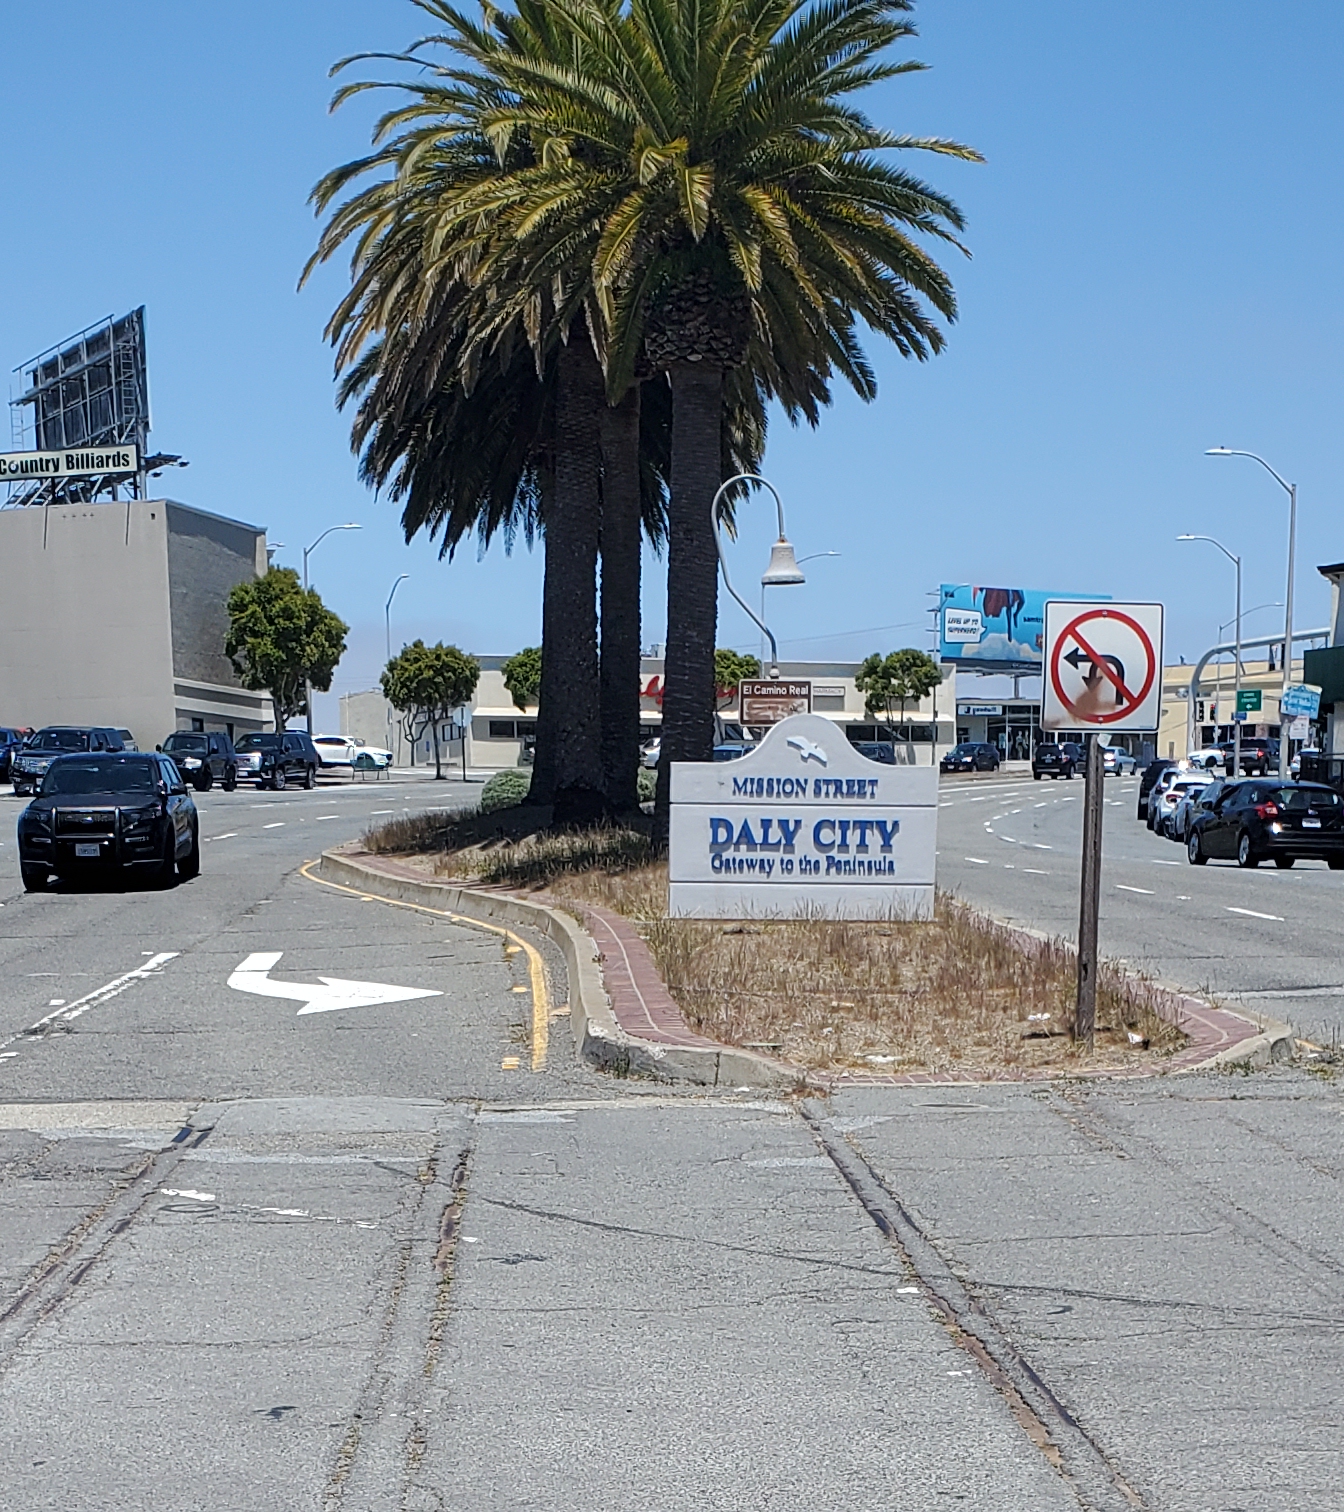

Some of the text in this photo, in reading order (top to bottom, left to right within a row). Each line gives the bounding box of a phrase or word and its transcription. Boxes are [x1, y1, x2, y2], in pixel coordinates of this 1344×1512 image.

[65, 450, 131, 471] Billiards
[743, 684, 751, 694] El
[754, 684, 787, 695] Camino
[789, 684, 809, 695] Real
[732, 777, 879, 798] MISSION STREET
[709, 817, 900, 852] DALY CITY
[711, 853, 896, 878] Gateway to the Peninsula
